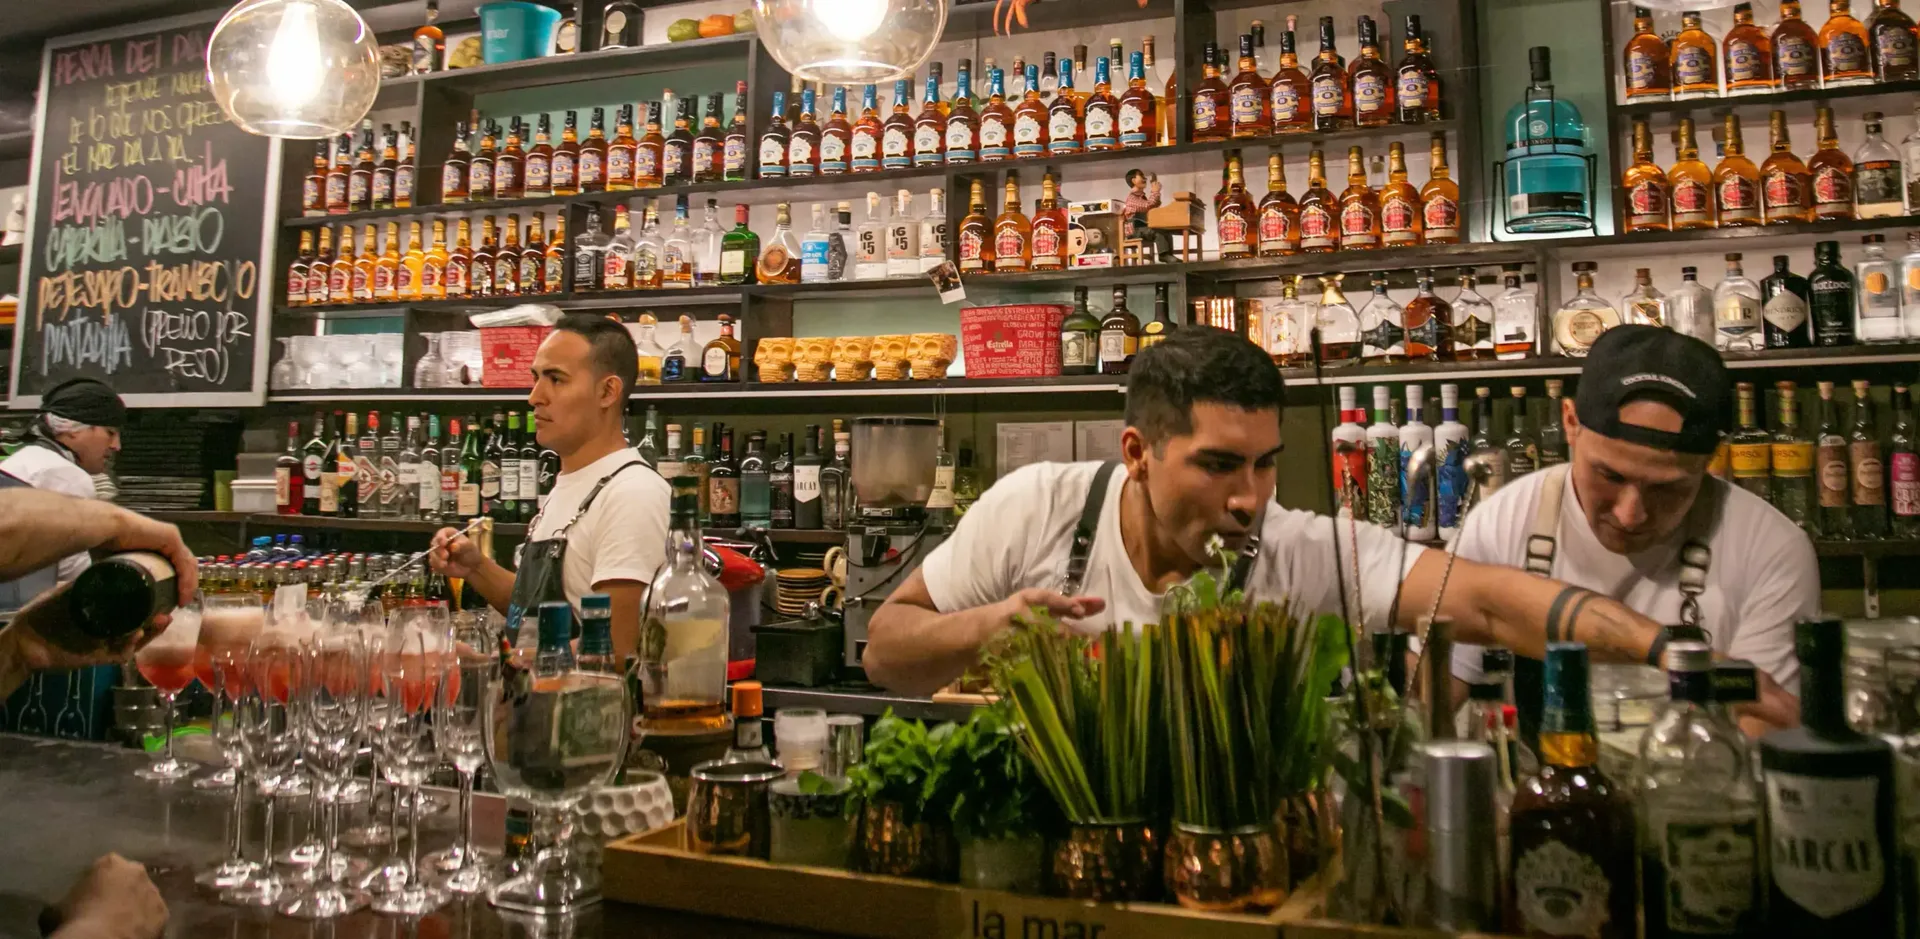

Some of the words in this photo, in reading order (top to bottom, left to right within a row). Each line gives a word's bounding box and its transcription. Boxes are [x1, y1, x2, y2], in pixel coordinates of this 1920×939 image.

[860, 231, 873, 241] 16
[892, 226, 906, 237] 16
[863, 241, 875, 255] 15
[896, 237, 908, 250] 15
[986, 339, 1013, 349] Estrella
[1019, 340, 1045, 348] MALT
[796, 481, 817, 491] ARCAY
[973, 900, 1005, 938] la
[1024, 915, 1106, 939] mar
